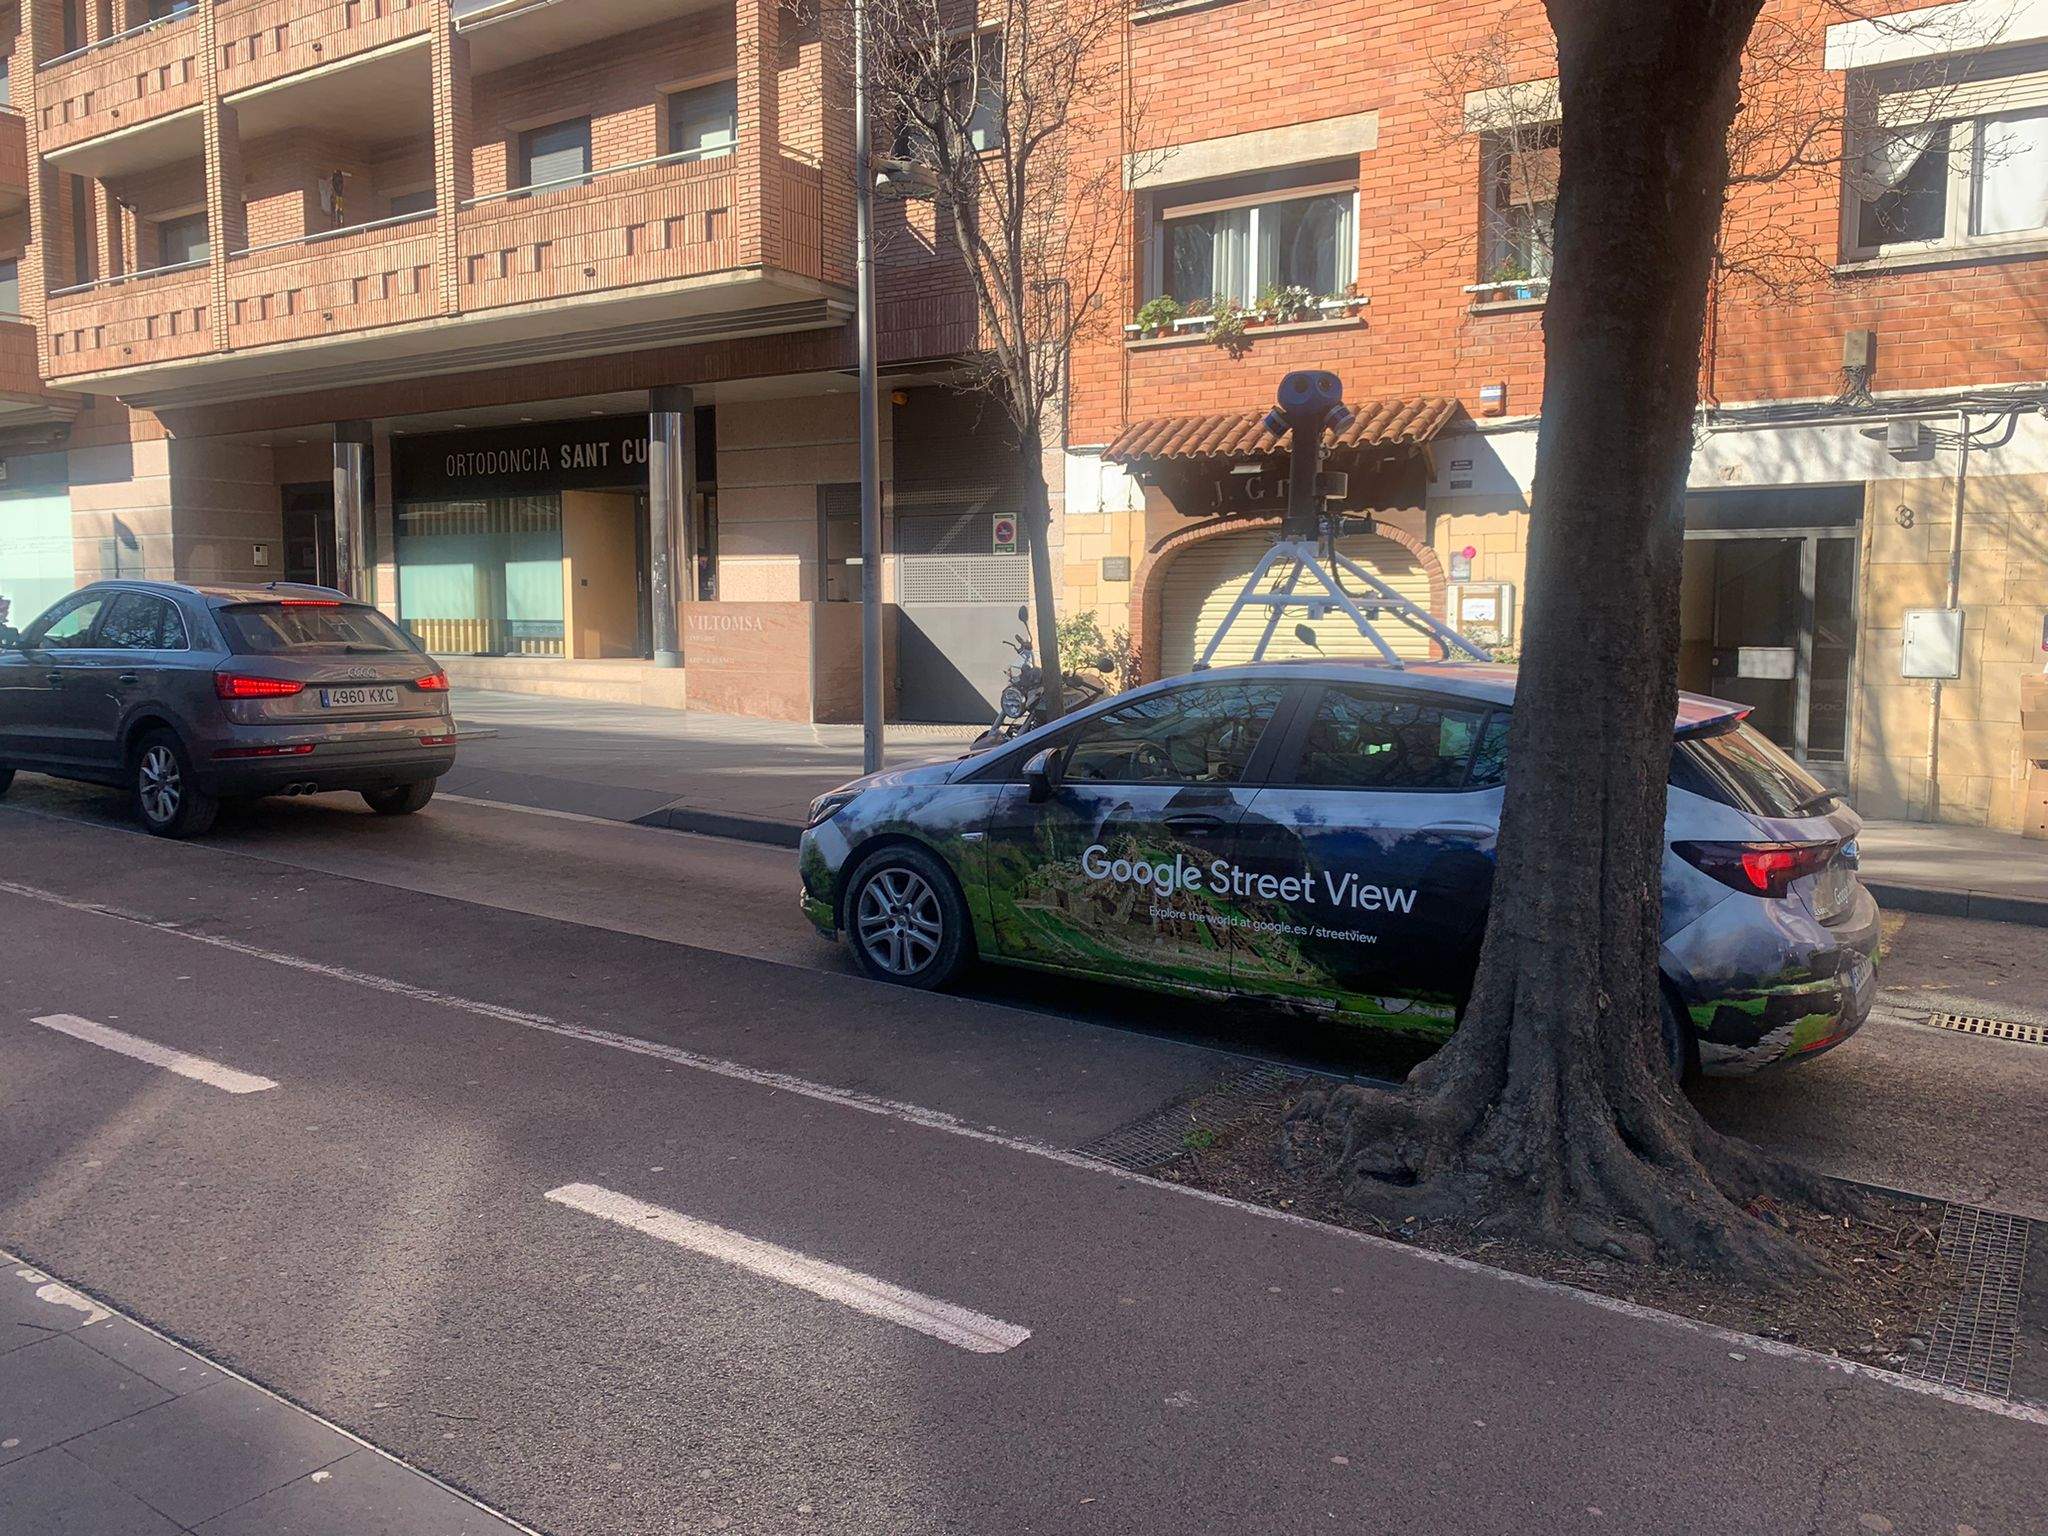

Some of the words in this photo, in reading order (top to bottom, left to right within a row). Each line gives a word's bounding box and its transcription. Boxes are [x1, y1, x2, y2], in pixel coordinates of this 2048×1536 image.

[446, 448, 550, 477] ORTODONCIA
[560, 442, 610, 469] SANT
[621, 438, 648, 465] CU
[688, 615, 763, 631] VILTOMSA
[332, 690, 365, 704] 4960
[369, 688, 394, 703] KXC
[1081, 844, 1202, 897] Google
[1209, 859, 1316, 903] Street
[1324, 871, 1417, 914] View
[1149, 905, 1186, 920] Explore
[1188, 911, 1206, 922] the
[1206, 915, 1238, 926] world
[1240, 918, 1251, 928] at
[1315, 927, 1378, 944] streetview
